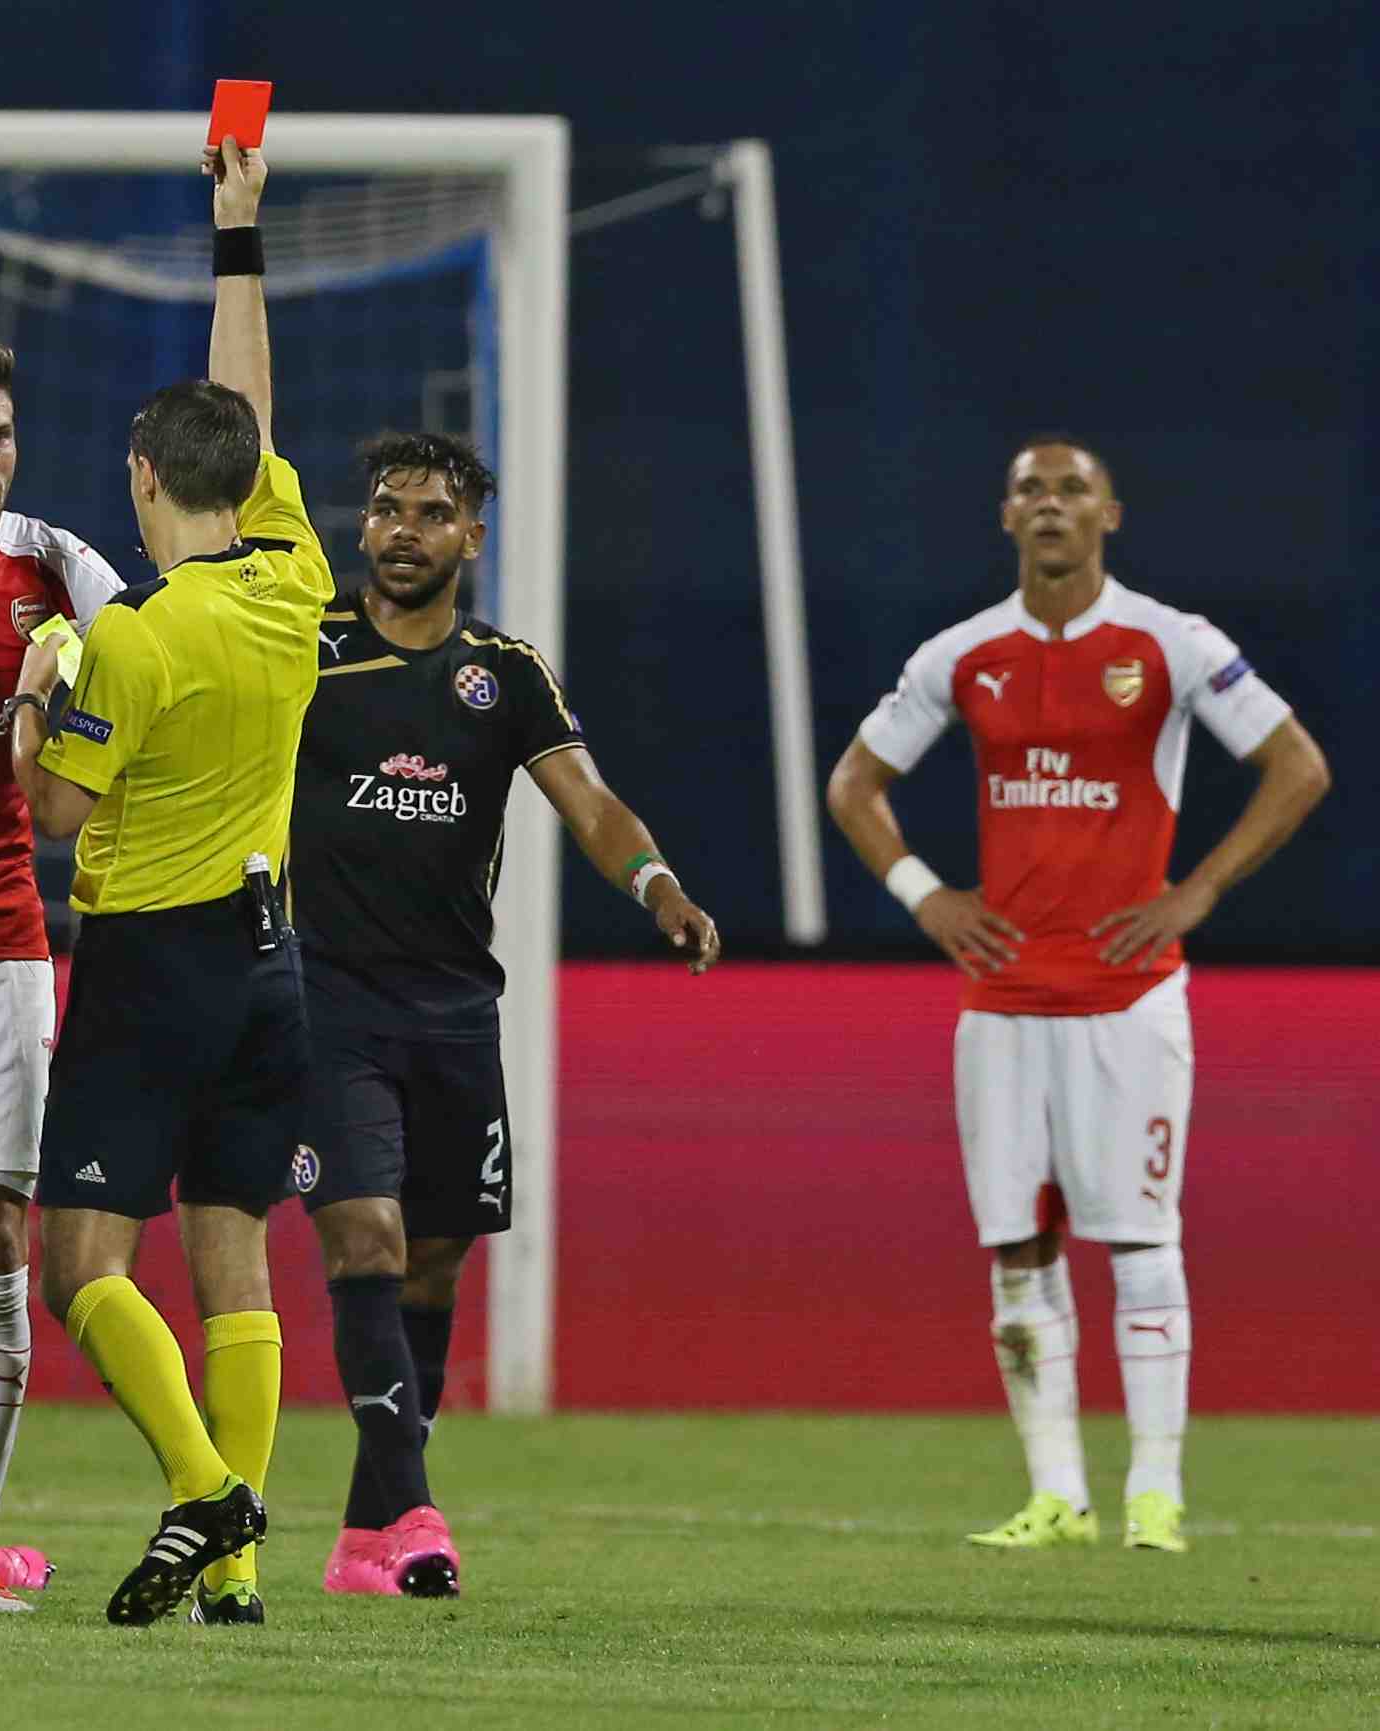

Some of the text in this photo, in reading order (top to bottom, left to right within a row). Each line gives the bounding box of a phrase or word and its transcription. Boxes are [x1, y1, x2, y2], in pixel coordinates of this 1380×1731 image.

[67, 712, 110, 738] ESPECT
[1026, 747, 1071, 777] Fly
[347, 774, 466, 820] Zagreb
[988, 770, 1119, 811] Emirates
[481, 1118, 504, 1184] 2
[1146, 1117, 1172, 1181] 3
